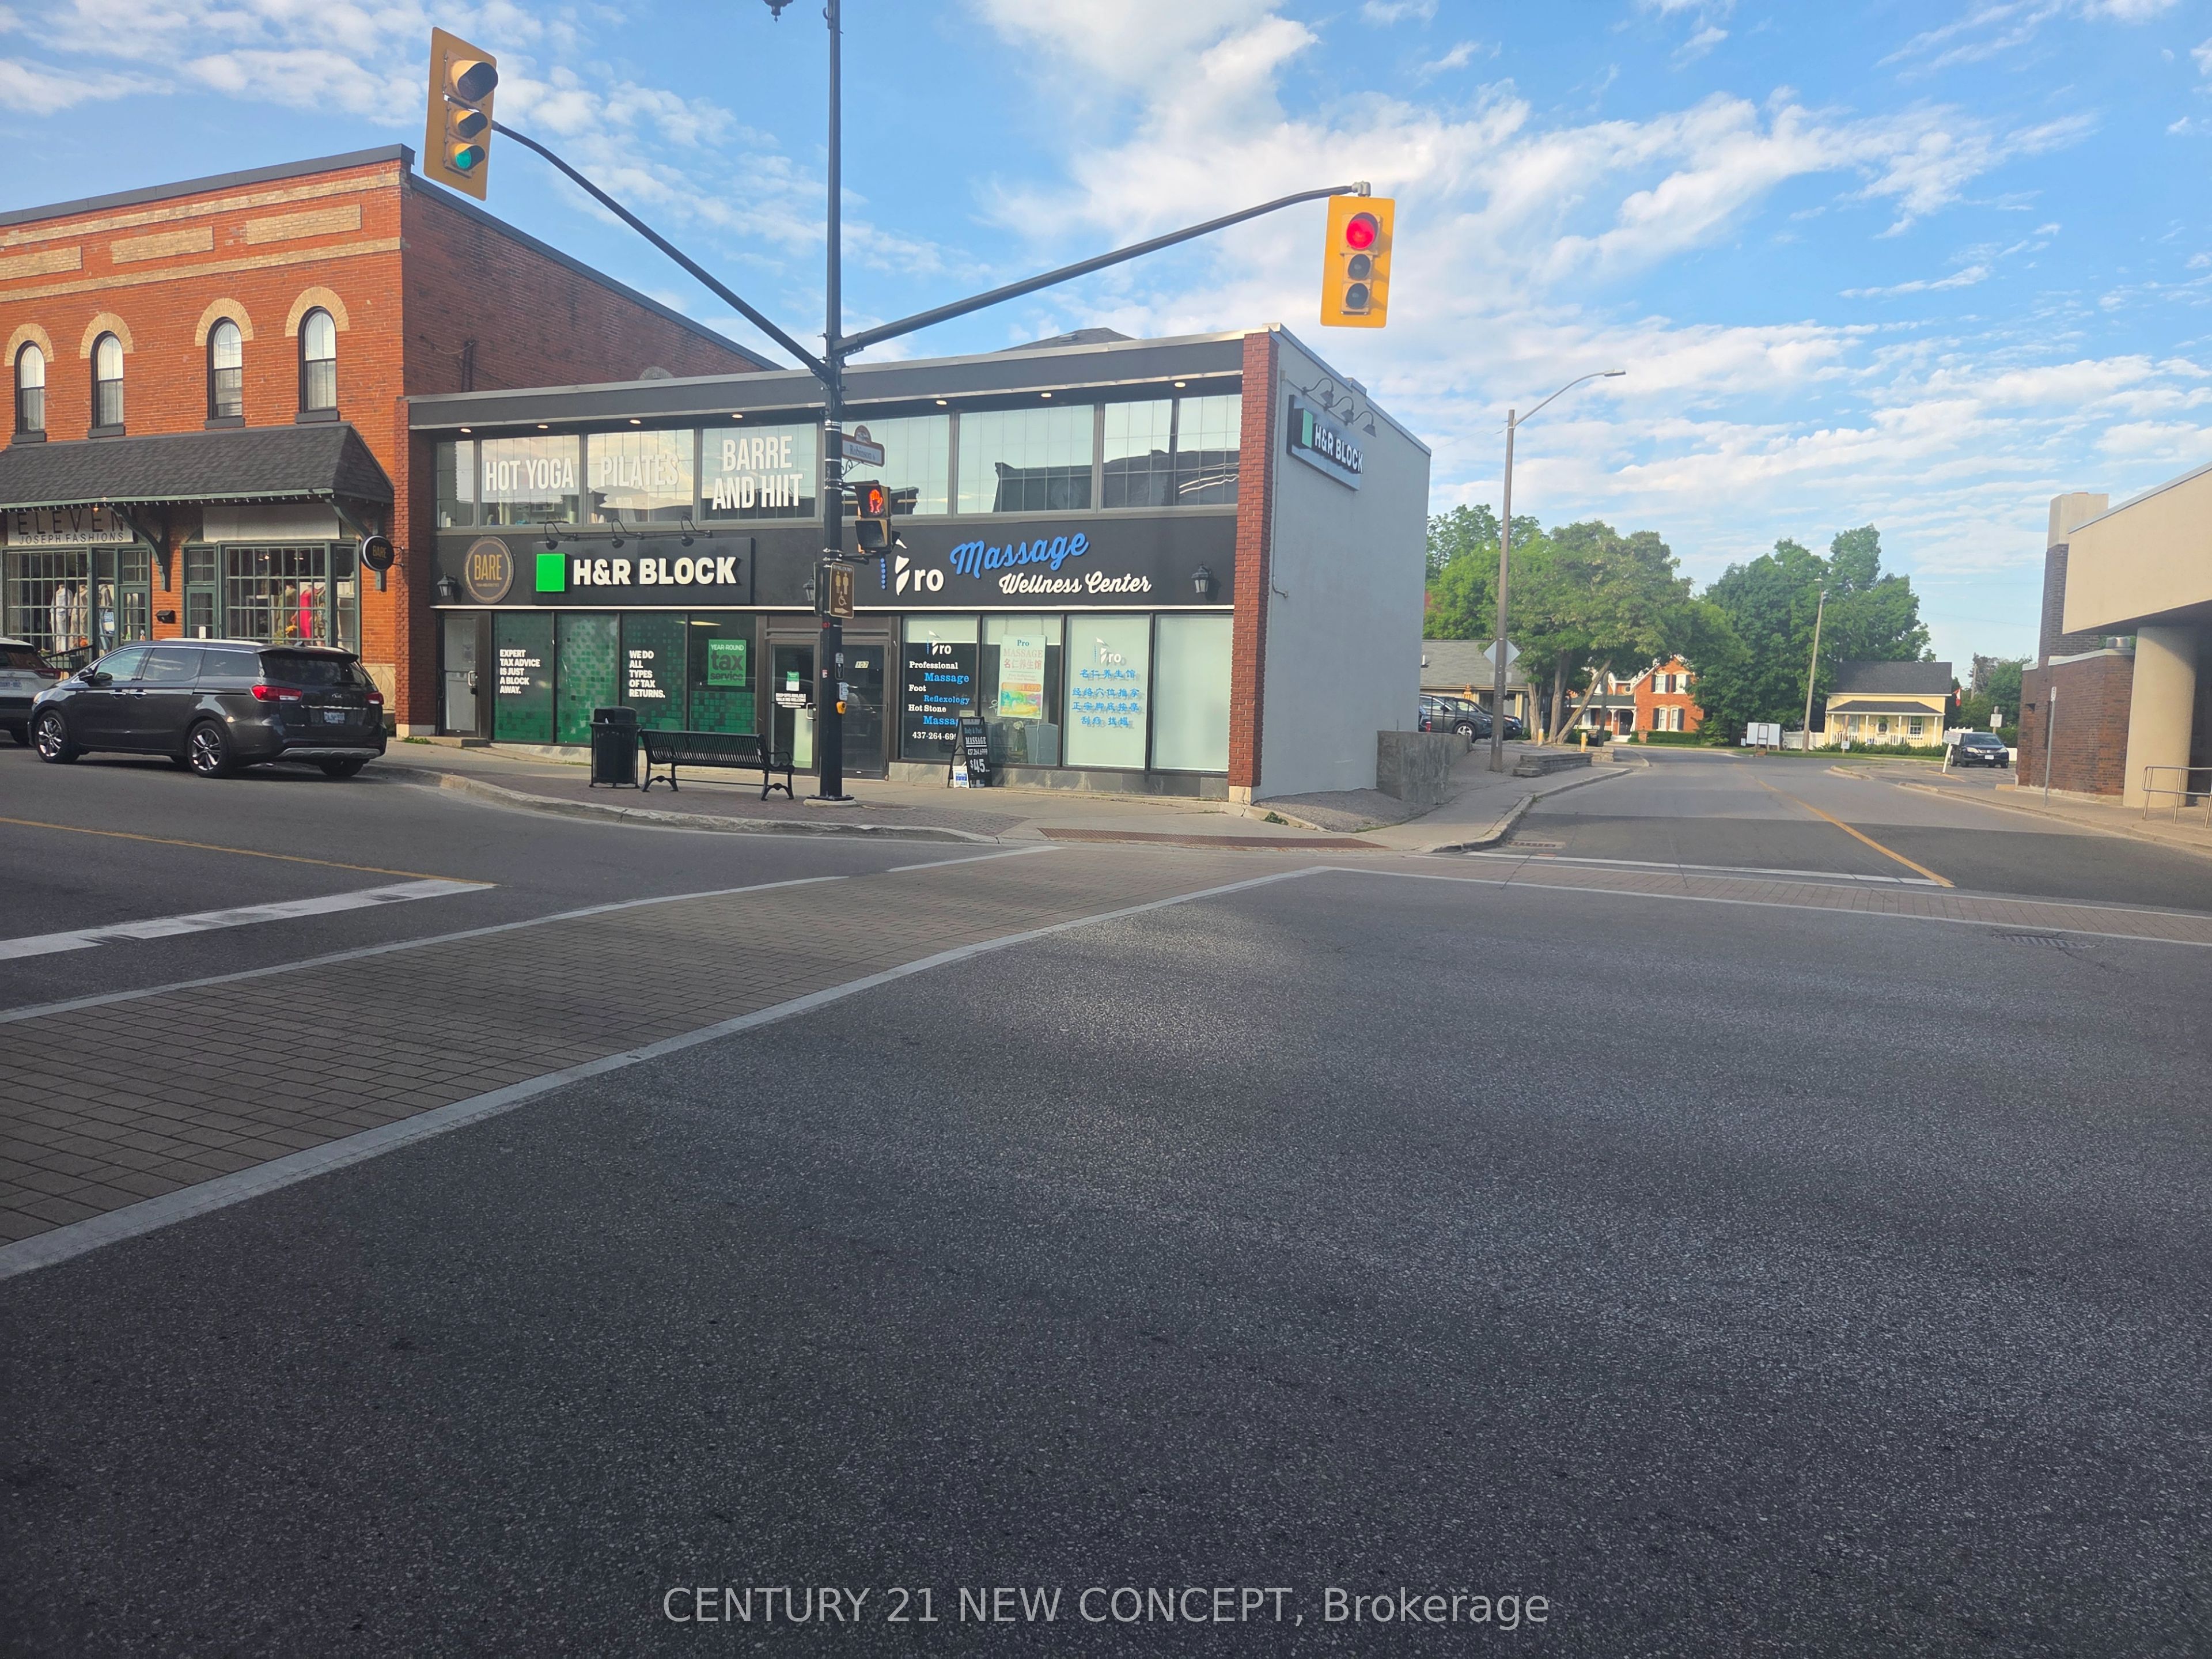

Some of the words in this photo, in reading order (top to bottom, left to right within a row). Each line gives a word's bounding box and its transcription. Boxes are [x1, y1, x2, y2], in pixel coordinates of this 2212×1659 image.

[723, 435, 793, 471] BARRE
[1315, 424, 1334, 456] H&R
[1336, 439, 1363, 474] BLOCK
[486, 460, 520, 491] HOT
[525, 458, 574, 490] YOGA
[600, 454, 680, 487] PILATES
[712, 476, 755, 510] AND
[761, 474, 803, 507] HIIT
[17, 509, 123, 535] ELEVEN
[19, 535, 61, 544] JOSEPH
[66, 532, 123, 543] FASHIONS
[950, 532, 1089, 579] Massage
[474, 554, 502, 581] BARE
[573, 558, 631, 585] H&R
[639, 556, 736, 585] BLOCK
[999, 571, 1082, 594] Wellness
[1085, 570, 1152, 593] Center
[500, 649, 526, 657] EXPERT
[629, 650, 642, 658] WE
[642, 650, 654, 659] DO
[1003, 649, 1043, 658] MASSAGE
[500, 658, 514, 666] TAX
[514, 658, 540, 667] ADVICE
[629, 660, 643, 668] ALL
[711, 650, 743, 671] tax
[909, 661, 959, 669] Professional
[1004, 658, 1041, 670] 名仁养生馆
[507, 668, 525, 676] JUST
[629, 669, 653, 678] TYPES
[710, 671, 743, 681] service
[1080, 669, 1135, 679] 名仁养生馆
[500, 676, 505, 684] A
[506, 677, 530, 685] BLOCK
[924, 672, 969, 684] Massage
[629, 679, 640, 687] OF
[641, 680, 656, 688] TAX
[500, 685, 521, 694] AWAY.
[629, 689, 665, 698] RETURNS.
[1072, 688, 1139, 698] 经络穴位推拿
[924, 695, 970, 704] Reflexology
[924, 704, 946, 713] Stone
[923, 716, 959, 727] Massa
[912, 731, 956, 740] 437-264-69
[965, 736, 987, 744] MASSAGE
[970, 759, 986, 773] $45
